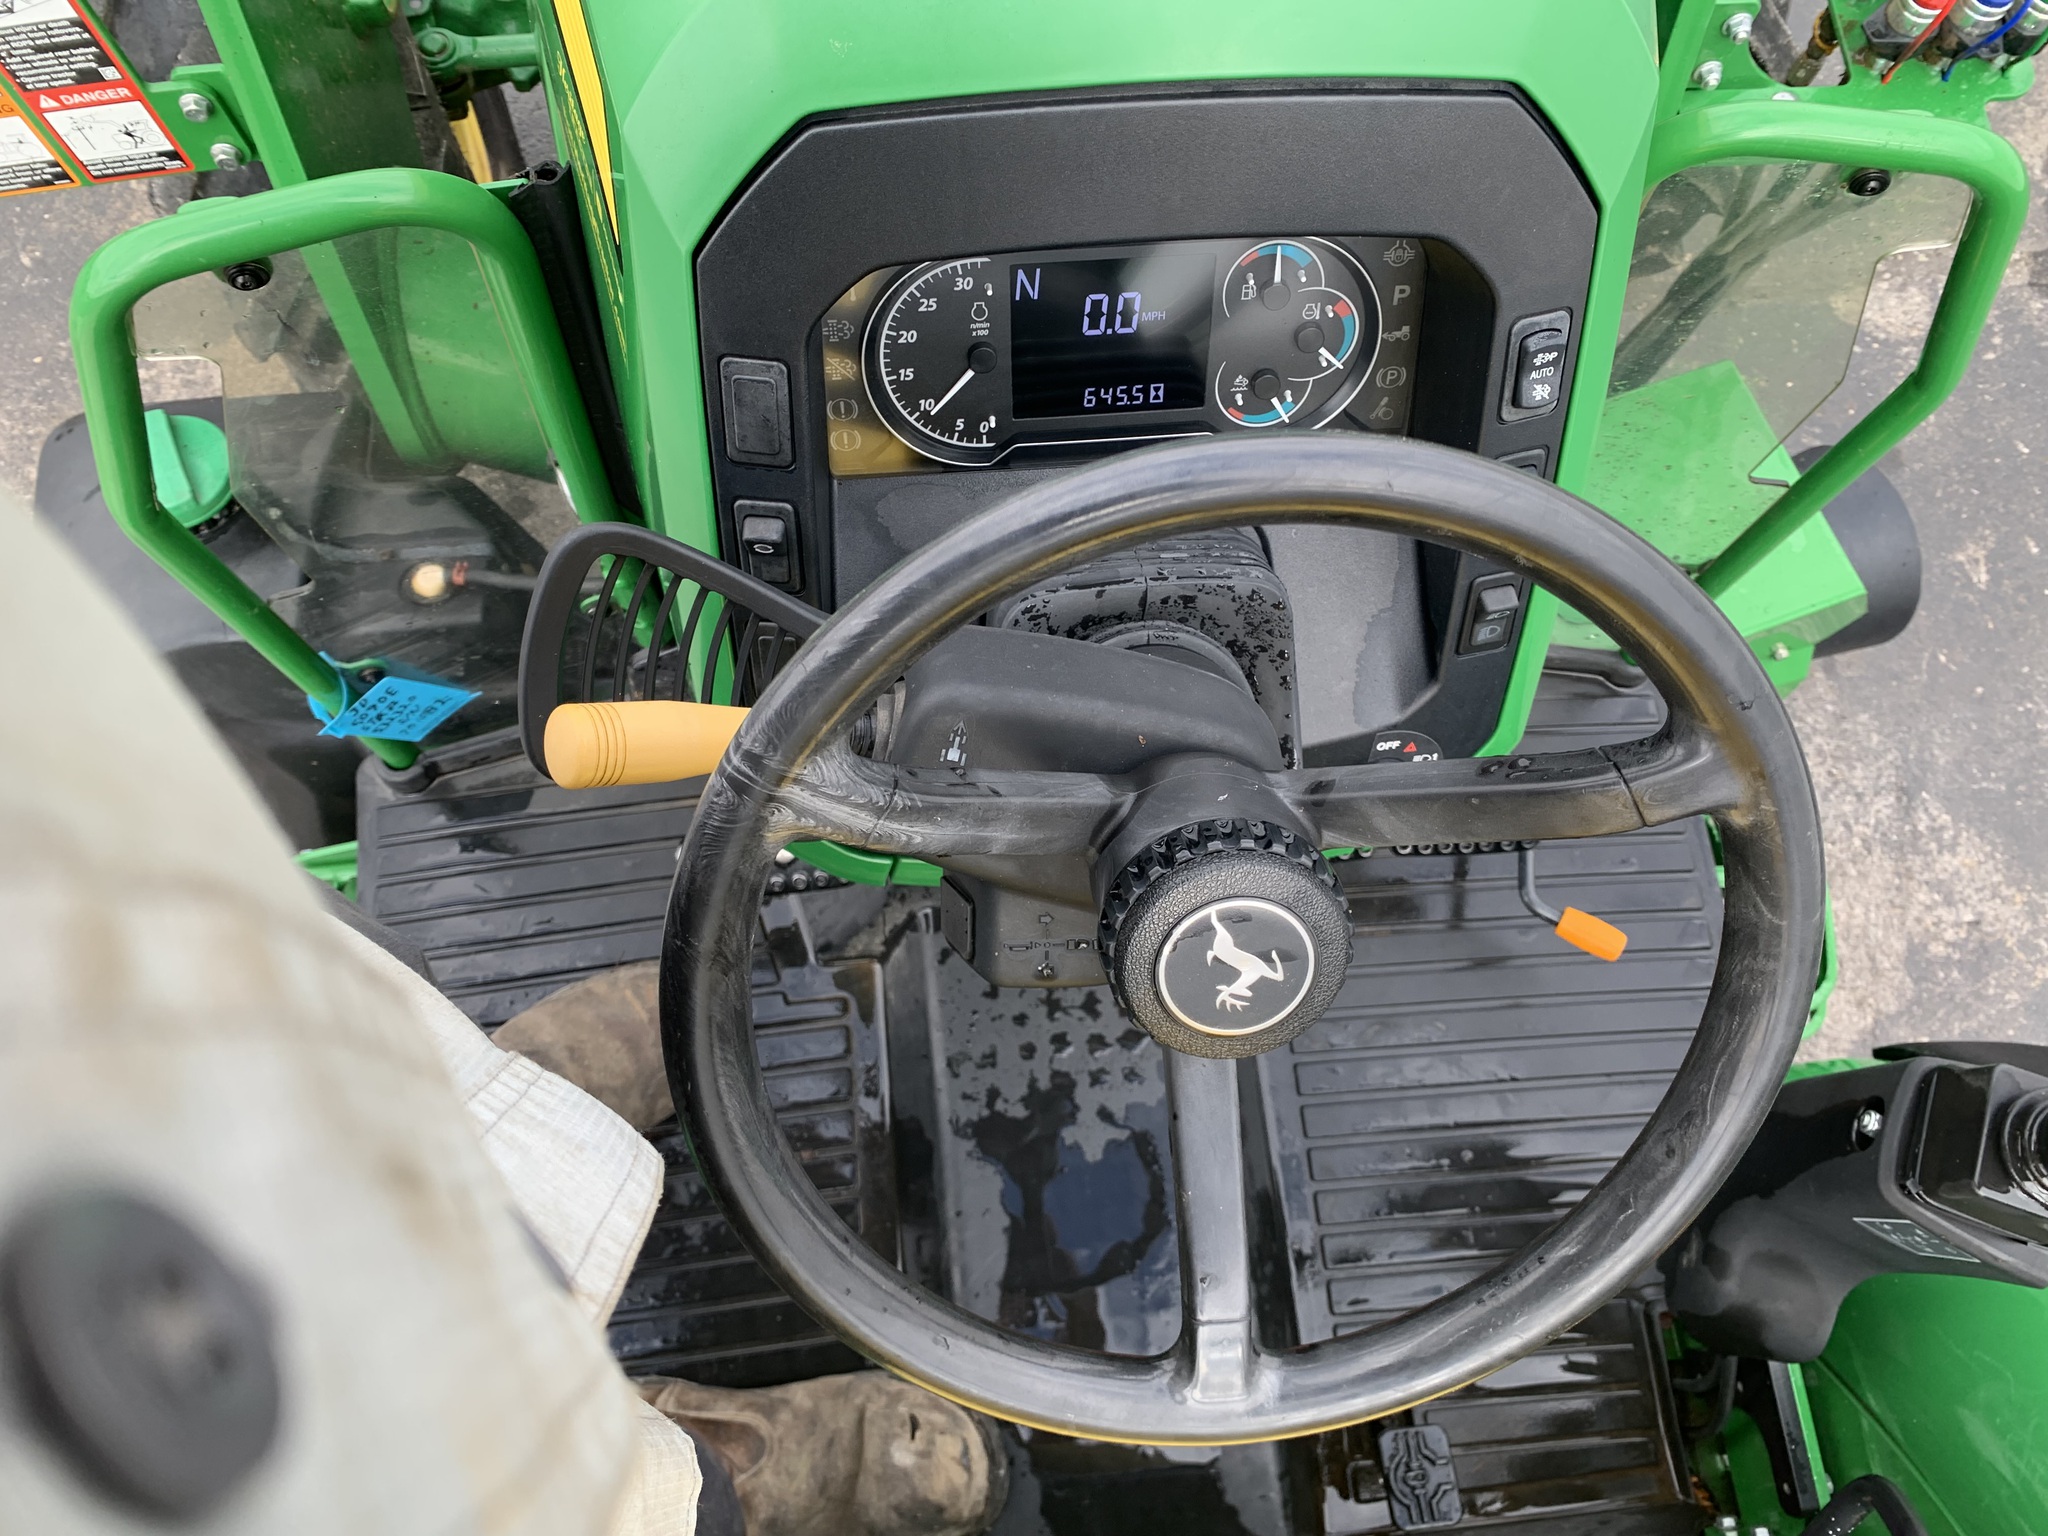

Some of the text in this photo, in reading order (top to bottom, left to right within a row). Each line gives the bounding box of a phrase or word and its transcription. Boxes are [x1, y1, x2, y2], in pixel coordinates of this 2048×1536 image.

[59, 87, 132, 106] DANGER
[954, 277, 973, 291] 30
[1015, 268, 1041, 301] N
[1392, 285, 1411, 306] P
[918, 298, 938, 312] 25
[1082, 291, 1166, 336] 0.0 MPH
[970, 321, 990, 329] n/min
[898, 330, 917, 343] 20
[972, 329, 989, 337] x100
[899, 367, 914, 381] 15
[1530, 367, 1554, 380] AUTO
[1084, 384, 1143, 407] 645.5
[919, 398, 935, 412] 10
[956, 418, 965, 431] 5
[979, 421, 989, 434] 0
[1376, 740, 1402, 751] OFF
